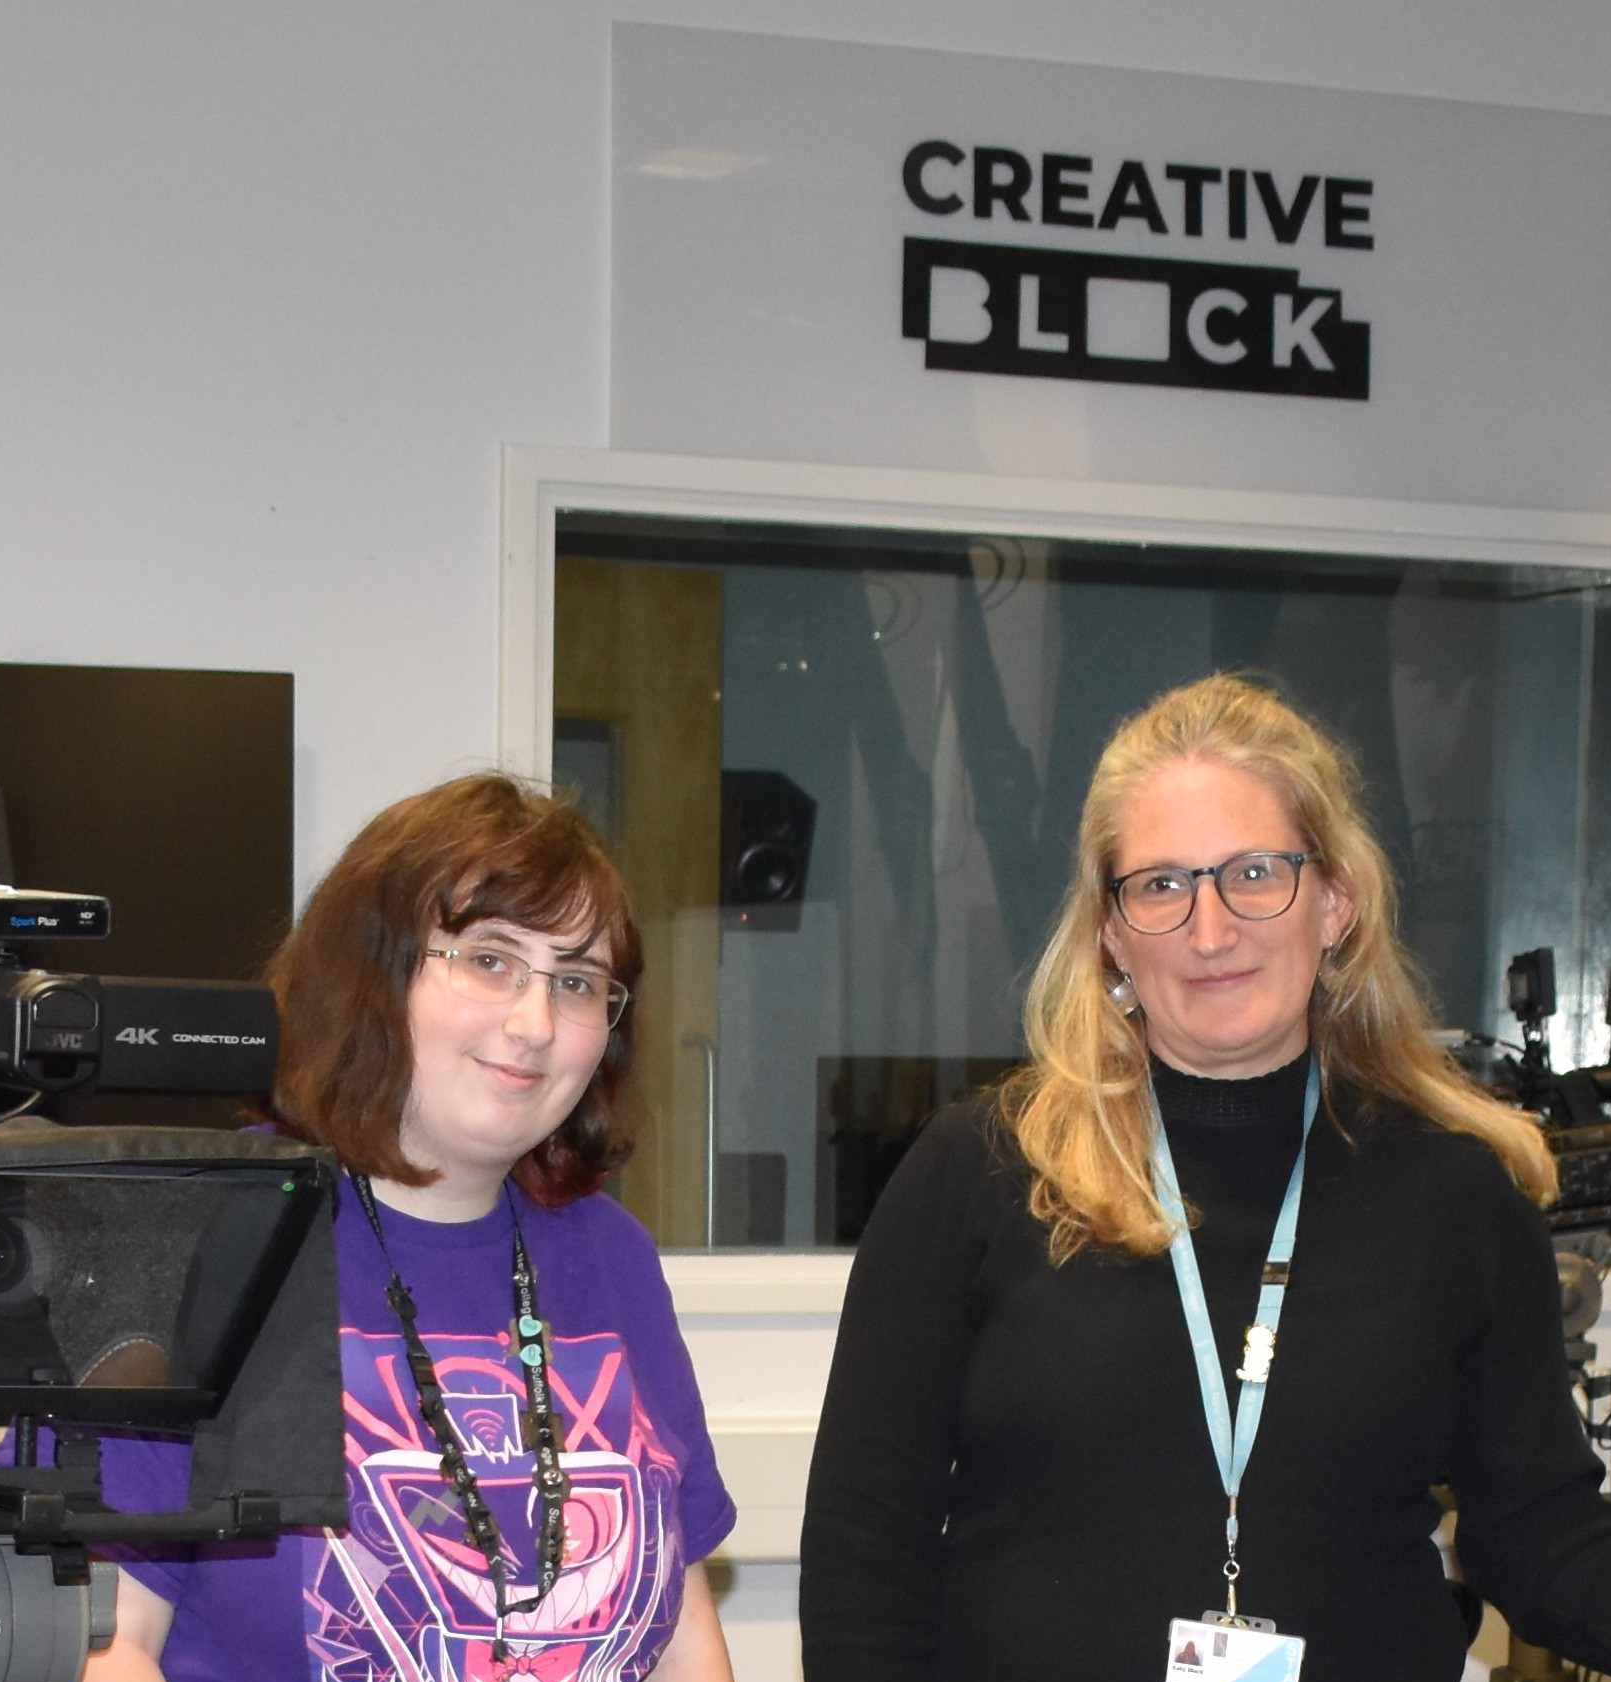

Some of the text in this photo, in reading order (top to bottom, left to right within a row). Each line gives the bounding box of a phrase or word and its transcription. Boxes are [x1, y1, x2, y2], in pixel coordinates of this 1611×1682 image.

[902, 139, 1374, 251] CREATIVE
[37, 916, 59, 927] Plus
[115, 1026, 267, 1046] 4K CONNECTED CAM
